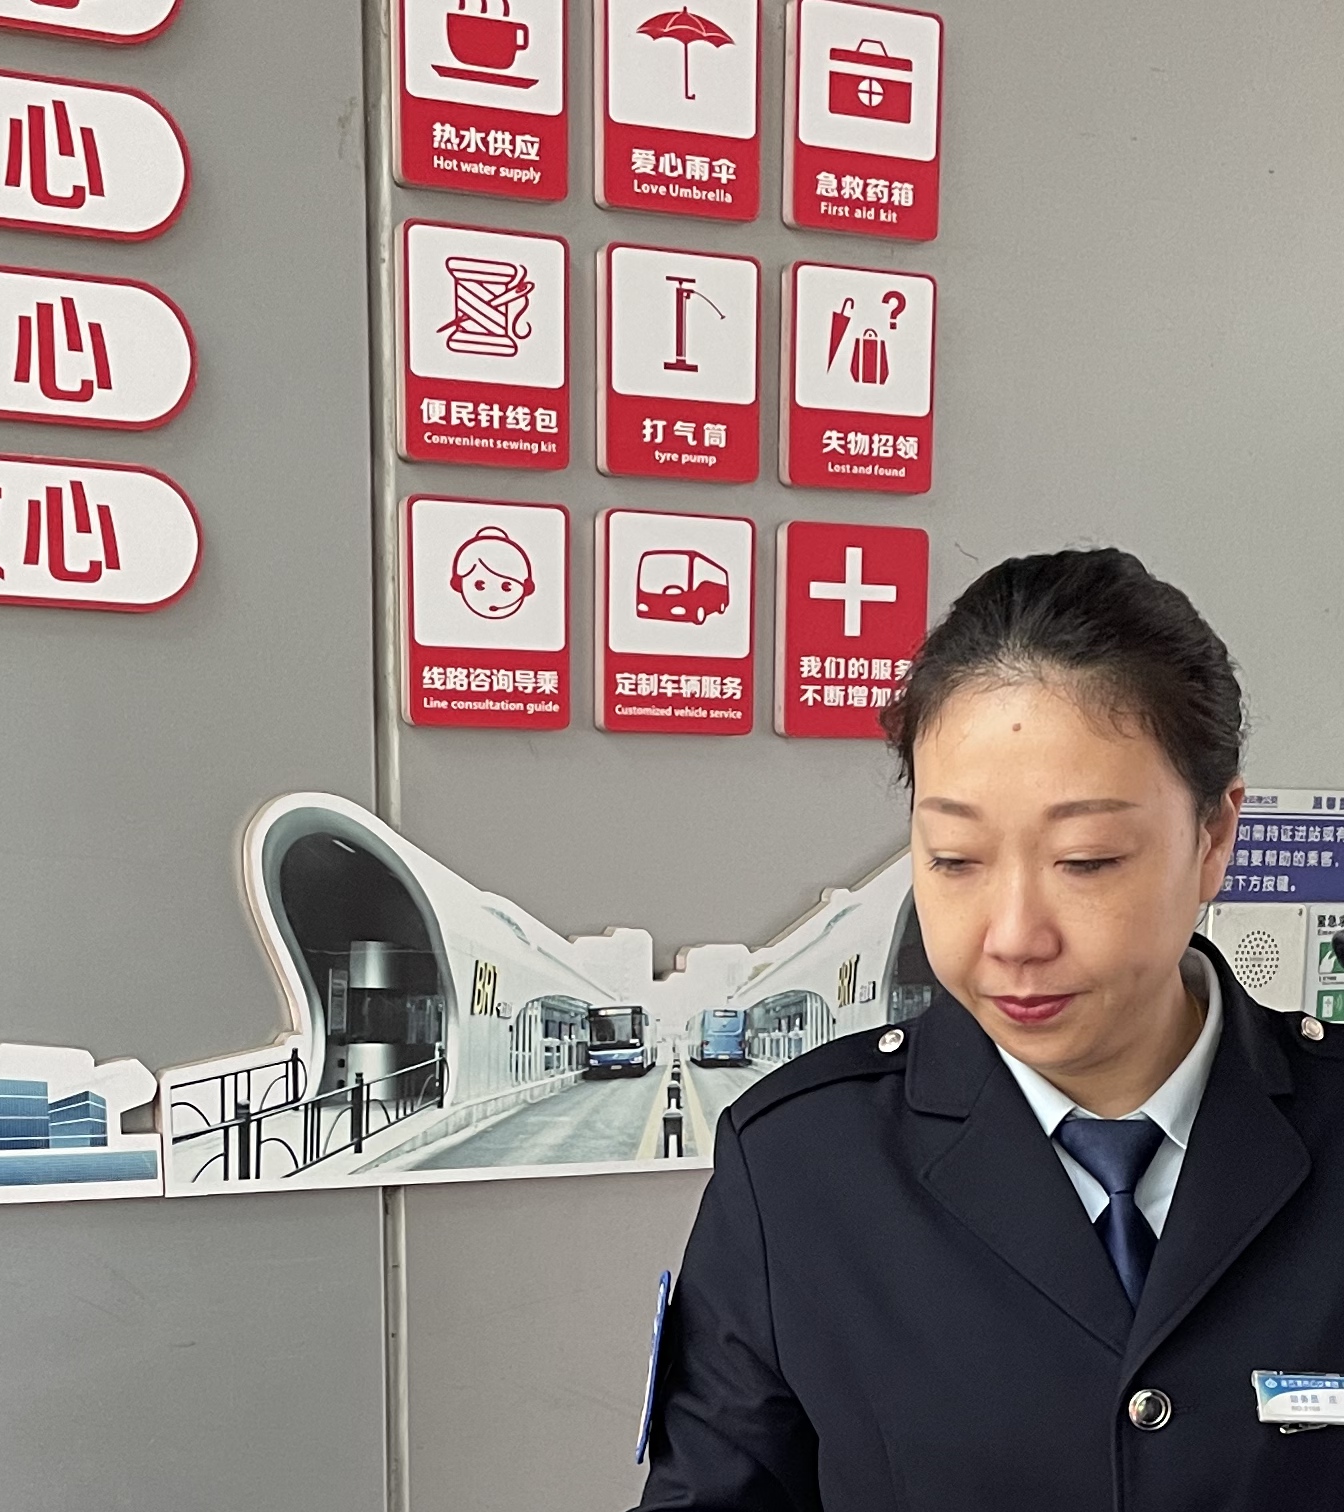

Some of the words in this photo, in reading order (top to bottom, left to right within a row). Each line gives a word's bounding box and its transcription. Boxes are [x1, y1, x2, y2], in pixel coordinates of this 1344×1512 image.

[432, 121, 541, 161] 热水供应
[432, 155, 459, 172] Hot
[460, 161, 497, 176] water
[499, 166, 542, 185] supply
[630, 148, 737, 185] 爱心雨伞
[633, 179, 667, 196] Love
[669, 183, 733, 204] Umbrella
[815, 171, 915, 208] 急救药箱
[820, 201, 850, 217] First
[854, 206, 875, 221] aid
[879, 208, 898, 224] kit
[419, 396, 559, 434] 便民针线包
[423, 431, 495, 448] Convenient
[496, 438, 539, 455] sewing
[540, 440, 558, 453] kit
[641, 417, 727, 449] 打气筒
[821, 429, 919, 461] 失物招领
[654, 449, 679, 464] tyre
[681, 452, 717, 467] pump
[827, 461, 852, 475] Lost
[852, 464, 872, 475] and
[873, 464, 906, 478] found
[421, 665, 559, 695] 线路咨询导乘
[614, 672, 743, 700] 定制车辆服务
[423, 696, 449, 710] Line
[450, 698, 524, 712] consultation
[526, 700, 560, 715] guide
[614, 703, 673, 717] Customized
[673, 706, 708, 719] vehicle
[709, 707, 743, 720] service
[471, 959, 498, 1017] BRT
